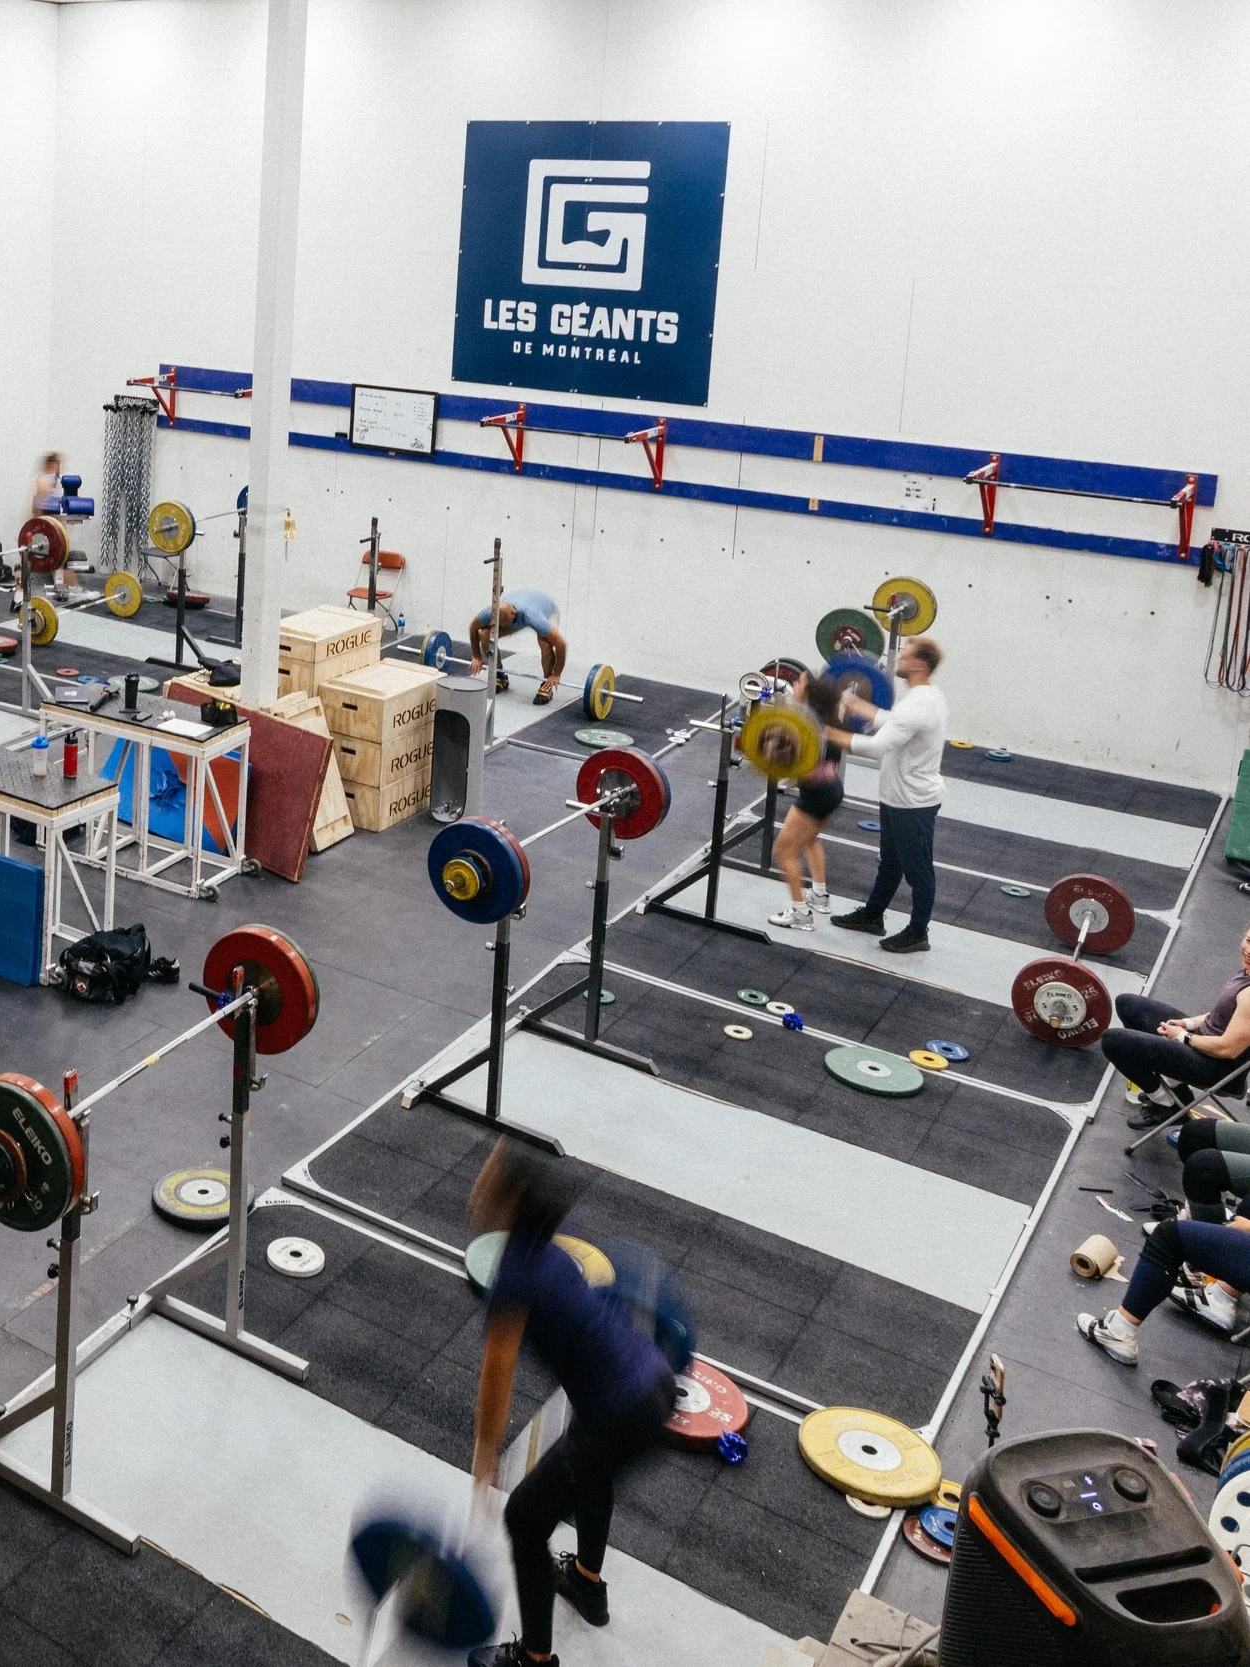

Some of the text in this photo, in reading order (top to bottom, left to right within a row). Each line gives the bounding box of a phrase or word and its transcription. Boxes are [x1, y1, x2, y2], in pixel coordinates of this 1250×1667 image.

[483, 299, 679, 344] LES GÉANTS
[513, 341, 641, 364] DE MONTRÉAL
[326, 629, 372, 658] ROGUE
[393, 698, 436, 729] ROGUE
[391, 741, 434, 773] ROGUE
[389, 784, 432, 817] ROGUE
[12, 1106, 52, 1166] ELEIKO
